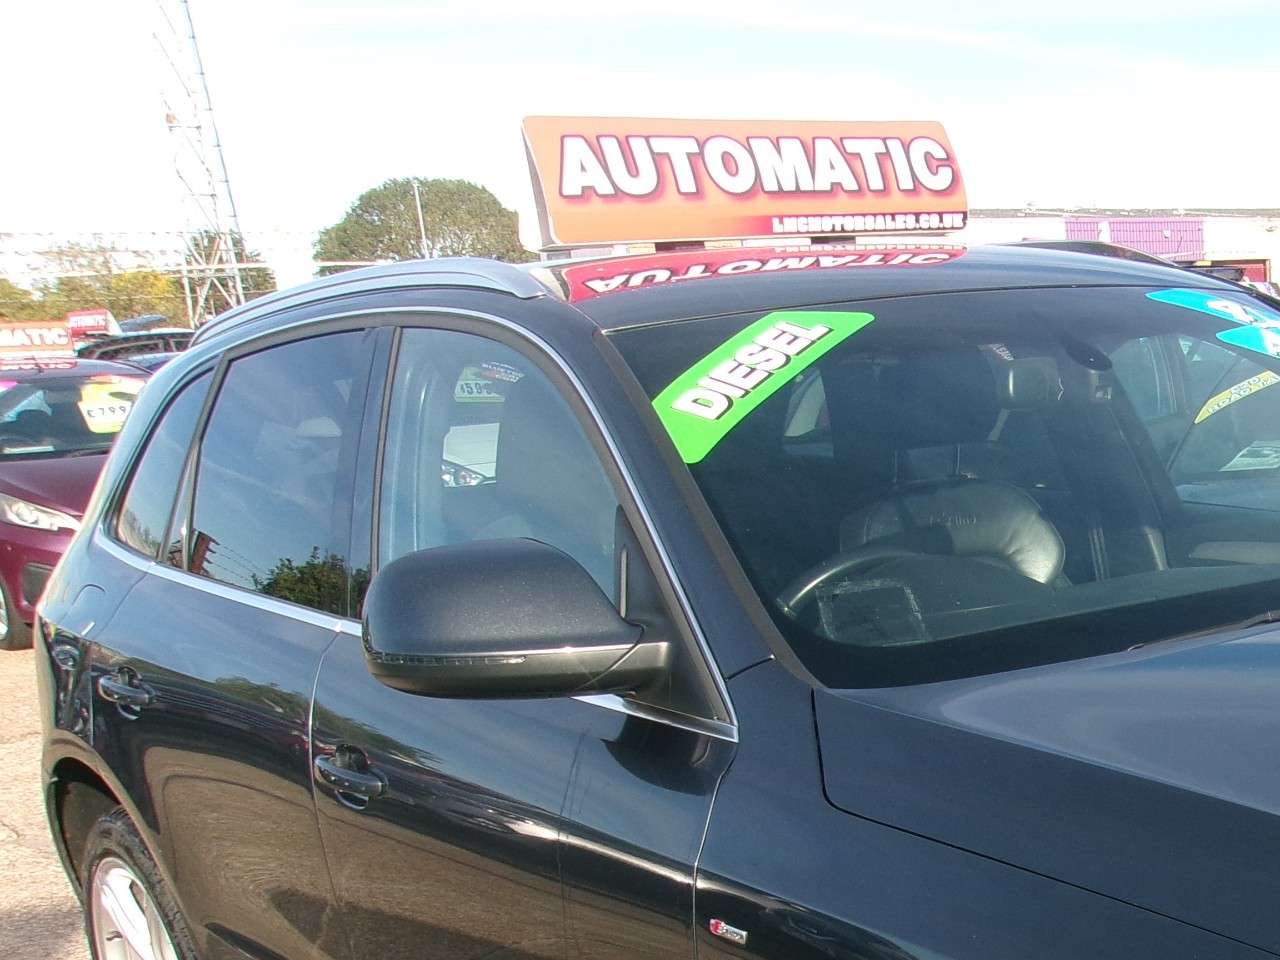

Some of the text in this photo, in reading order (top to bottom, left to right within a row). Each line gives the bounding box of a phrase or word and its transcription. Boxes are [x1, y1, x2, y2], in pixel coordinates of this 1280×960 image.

[560, 134, 954, 198] AUTOMATIC
[772, 212, 965, 234] LMCMOTORSALES.CO.UK
[671, 320, 834, 421] DIESEL
